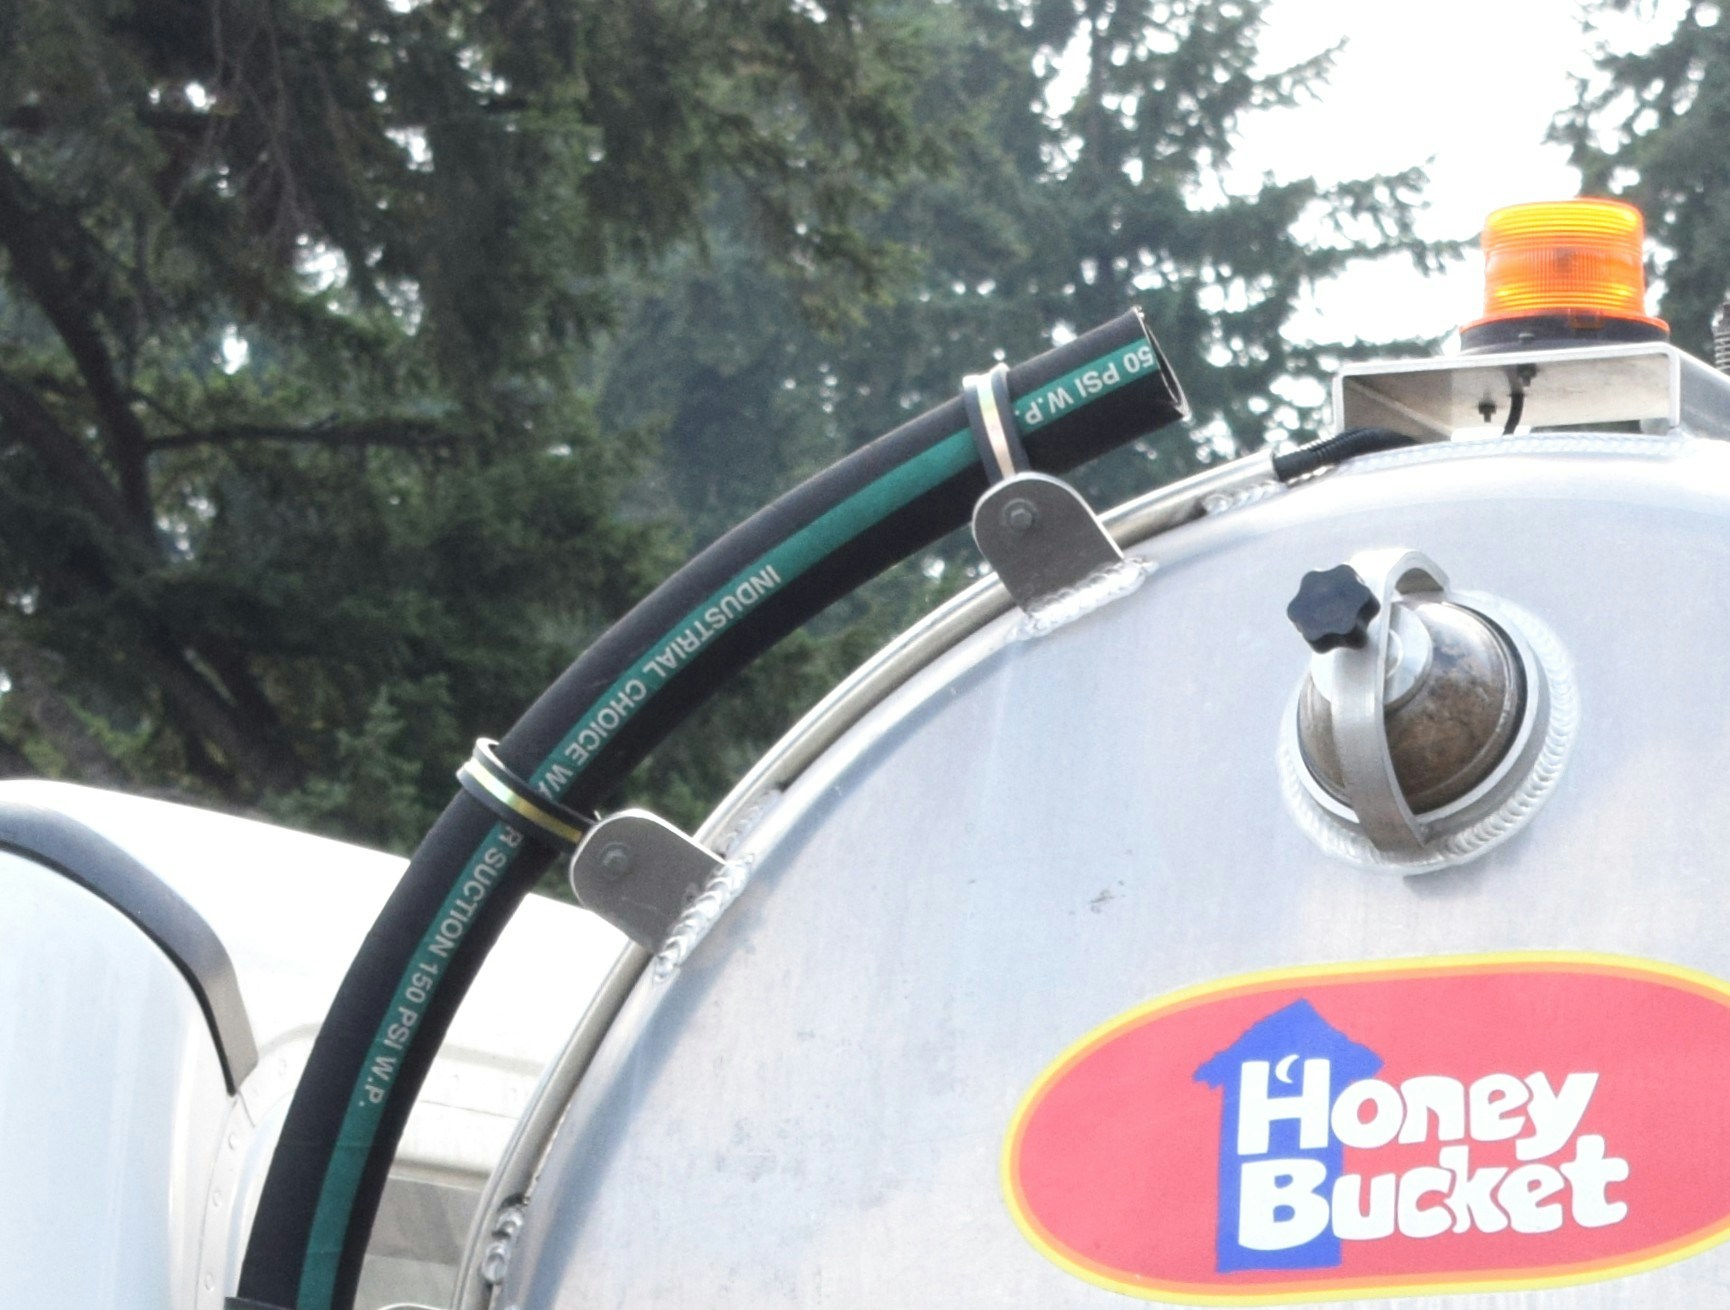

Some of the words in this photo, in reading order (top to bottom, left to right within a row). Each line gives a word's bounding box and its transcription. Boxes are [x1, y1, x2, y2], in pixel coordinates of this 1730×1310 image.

[1014, 387, 1074, 424] W.P.
[1074, 362, 1120, 397] PSI
[642, 564, 781, 678] INDUSTRIAL
[563, 678, 647, 765] CHOICE
[429, 848, 507, 958] SUCTION
[405, 962, 437, 1004] 150
[387, 1006, 418, 1050] PSI
[358, 1055, 397, 1107] W.P.
[1237, 1056, 1599, 1161] Honey
[1238, 1134, 1629, 1250] Bucket
